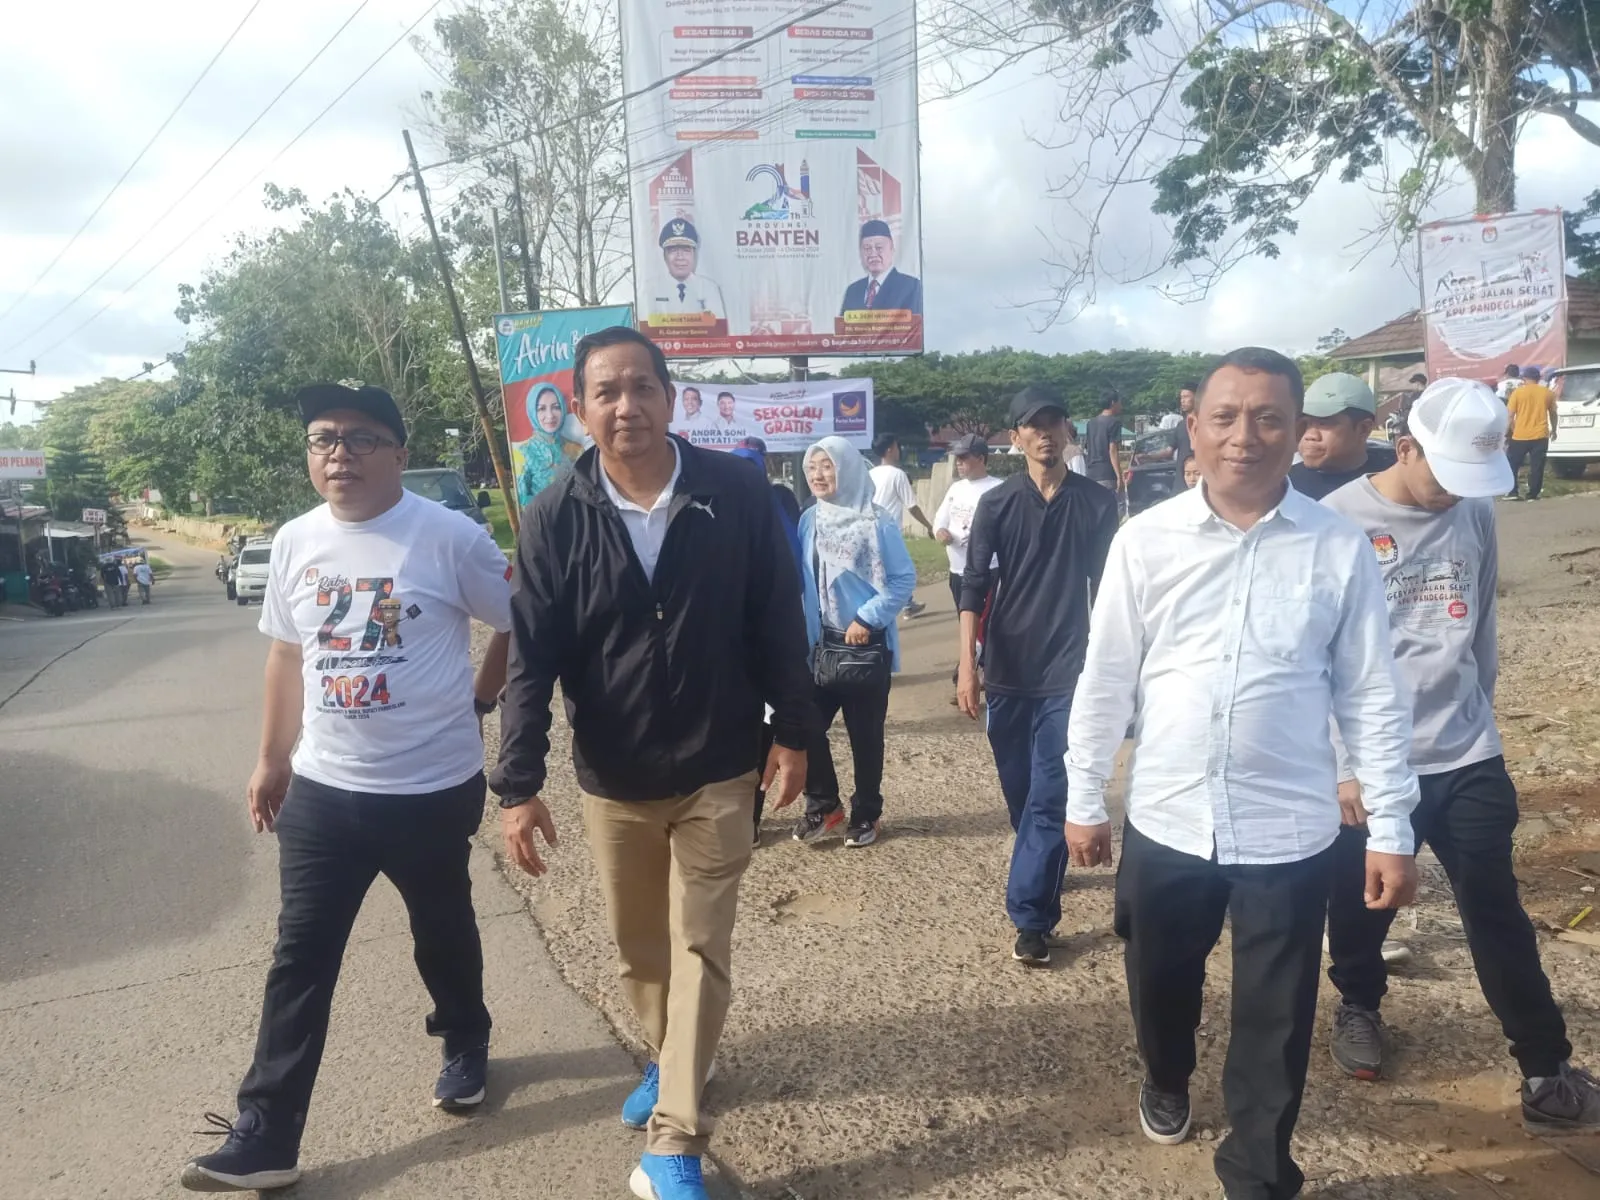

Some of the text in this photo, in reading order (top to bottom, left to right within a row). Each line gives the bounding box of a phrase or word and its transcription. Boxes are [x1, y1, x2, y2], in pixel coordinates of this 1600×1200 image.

[736, 230, 820, 246] BANTEN
[1481, 288, 1513, 298] JALAN
[1518, 285, 1554, 296] SEHAT
[1470, 298, 1538, 314] PANDEGLANG
[514, 332, 570, 374] Airin
[753, 405, 823, 422] SEKOLAH
[691, 429, 722, 437] ANDRA
[724, 429, 746, 437] SONI
[764, 420, 813, 434] GRATIS
[319, 574, 348, 592] Rabu
[1449, 583, 1471, 592] SEHAT
[317, 578, 394, 651] 27
[321, 672, 391, 708] 2024
